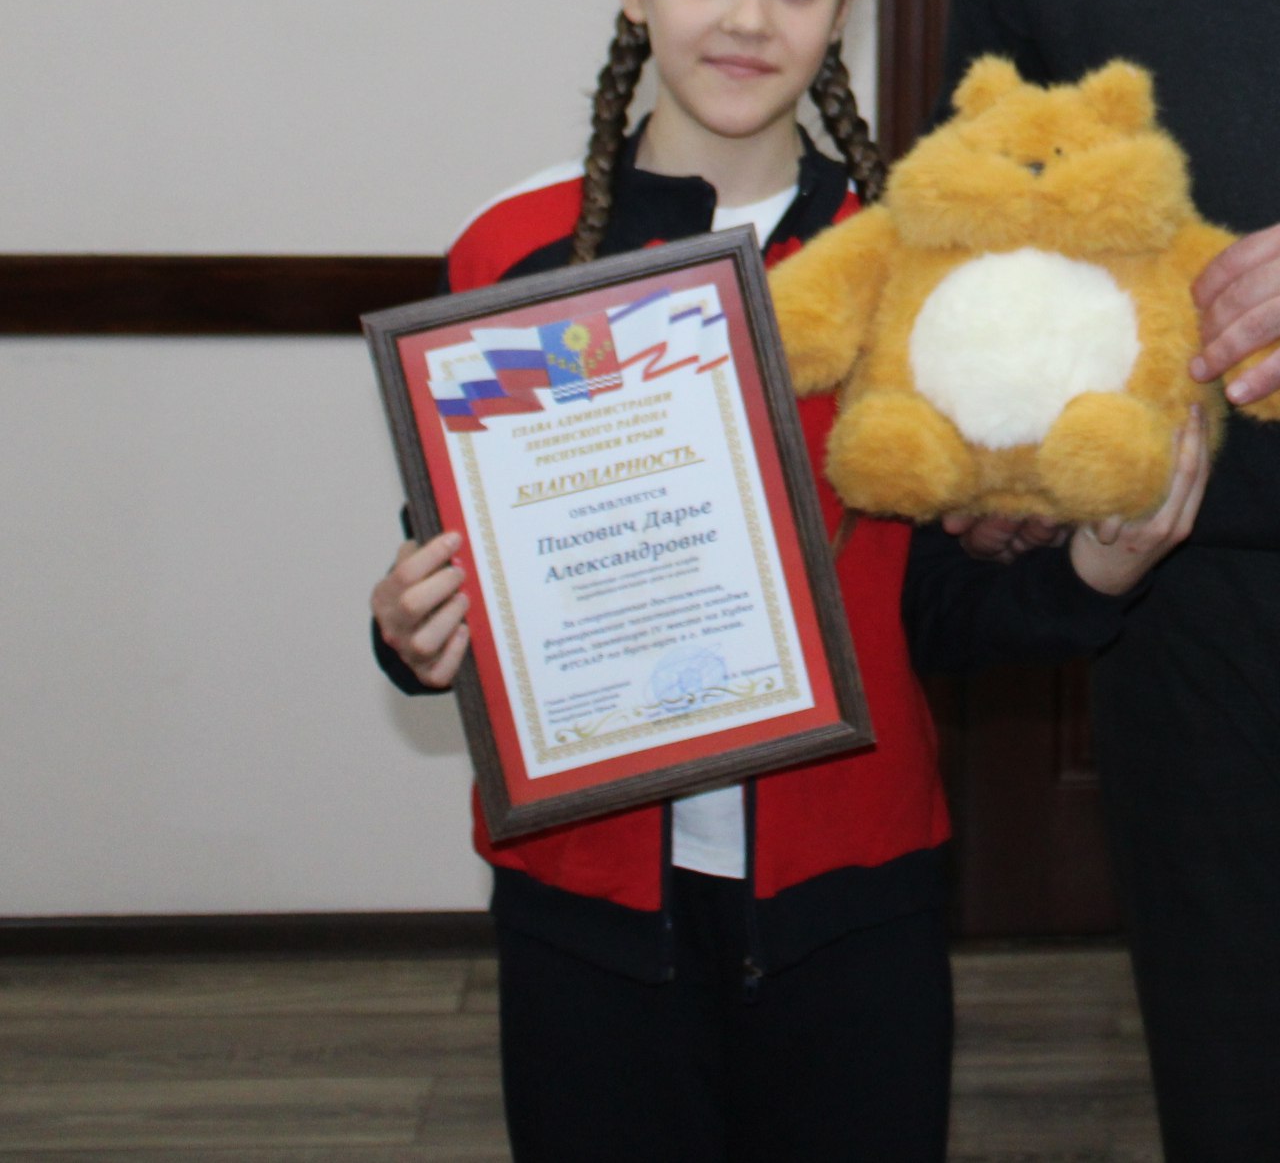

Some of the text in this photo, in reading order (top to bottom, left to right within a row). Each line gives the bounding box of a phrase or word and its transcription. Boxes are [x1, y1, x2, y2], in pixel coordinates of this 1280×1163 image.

[512, 391, 672, 438] ГЛАВА АДМИНИСТРАЦИИ
[527, 409, 667, 450] ЛЕНИНСКОГО РАЙОНА
[536, 426, 665, 466] РЕСПУБЛИКИ КРЫМ
[517, 444, 695, 501] БЛАГОДАРНОСТЬ
[570, 487, 666, 519] ОБЪЯВЛЯЕТСЯ
[537, 500, 712, 555] Пихович Дарье
[546, 530, 717, 583] Александровне
